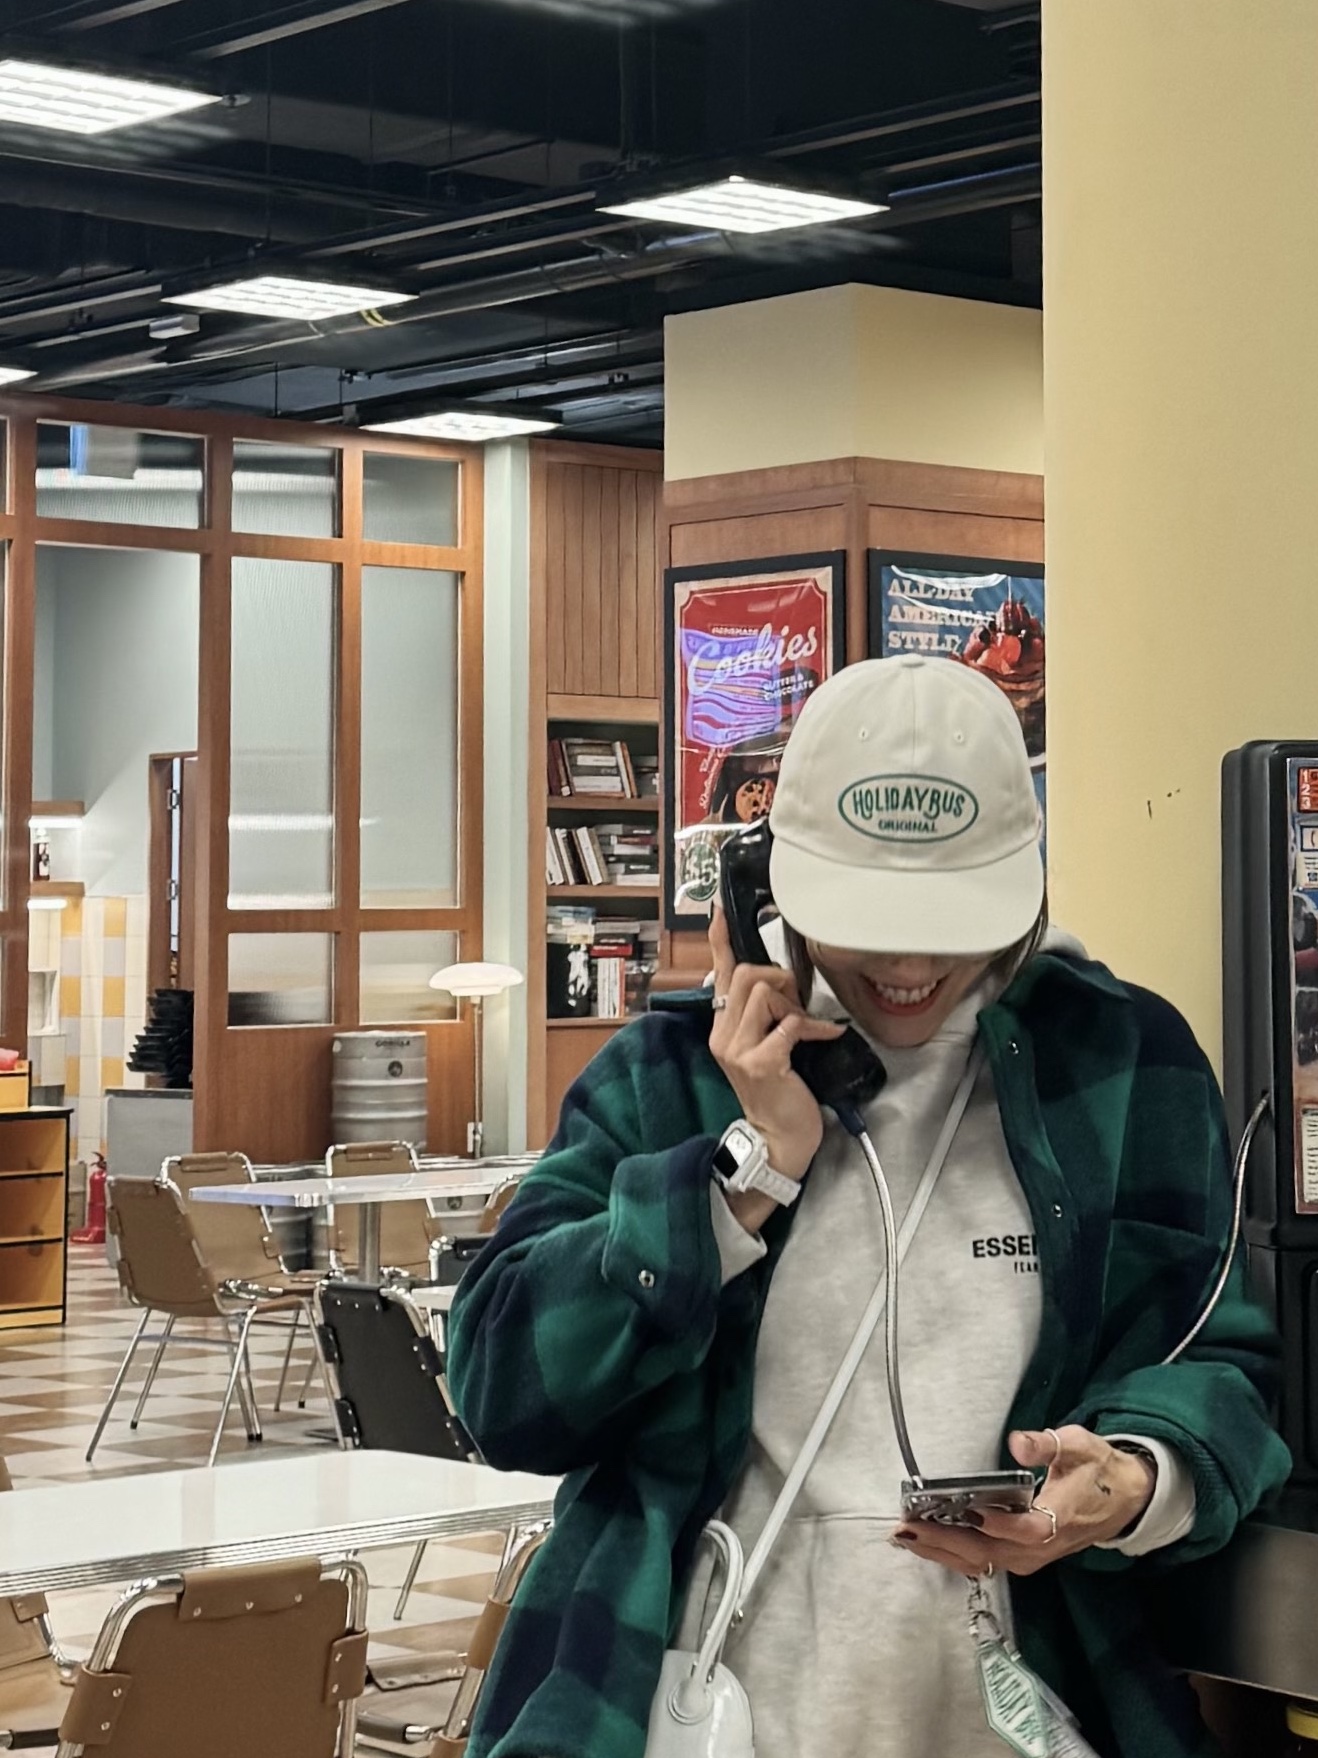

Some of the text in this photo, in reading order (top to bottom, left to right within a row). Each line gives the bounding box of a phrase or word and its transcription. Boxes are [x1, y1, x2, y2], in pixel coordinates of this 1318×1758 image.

[888, 630, 962, 653] STYLE
[688, 622, 818, 697] Cookies
[878, 819, 938, 833] ORIGINAL
